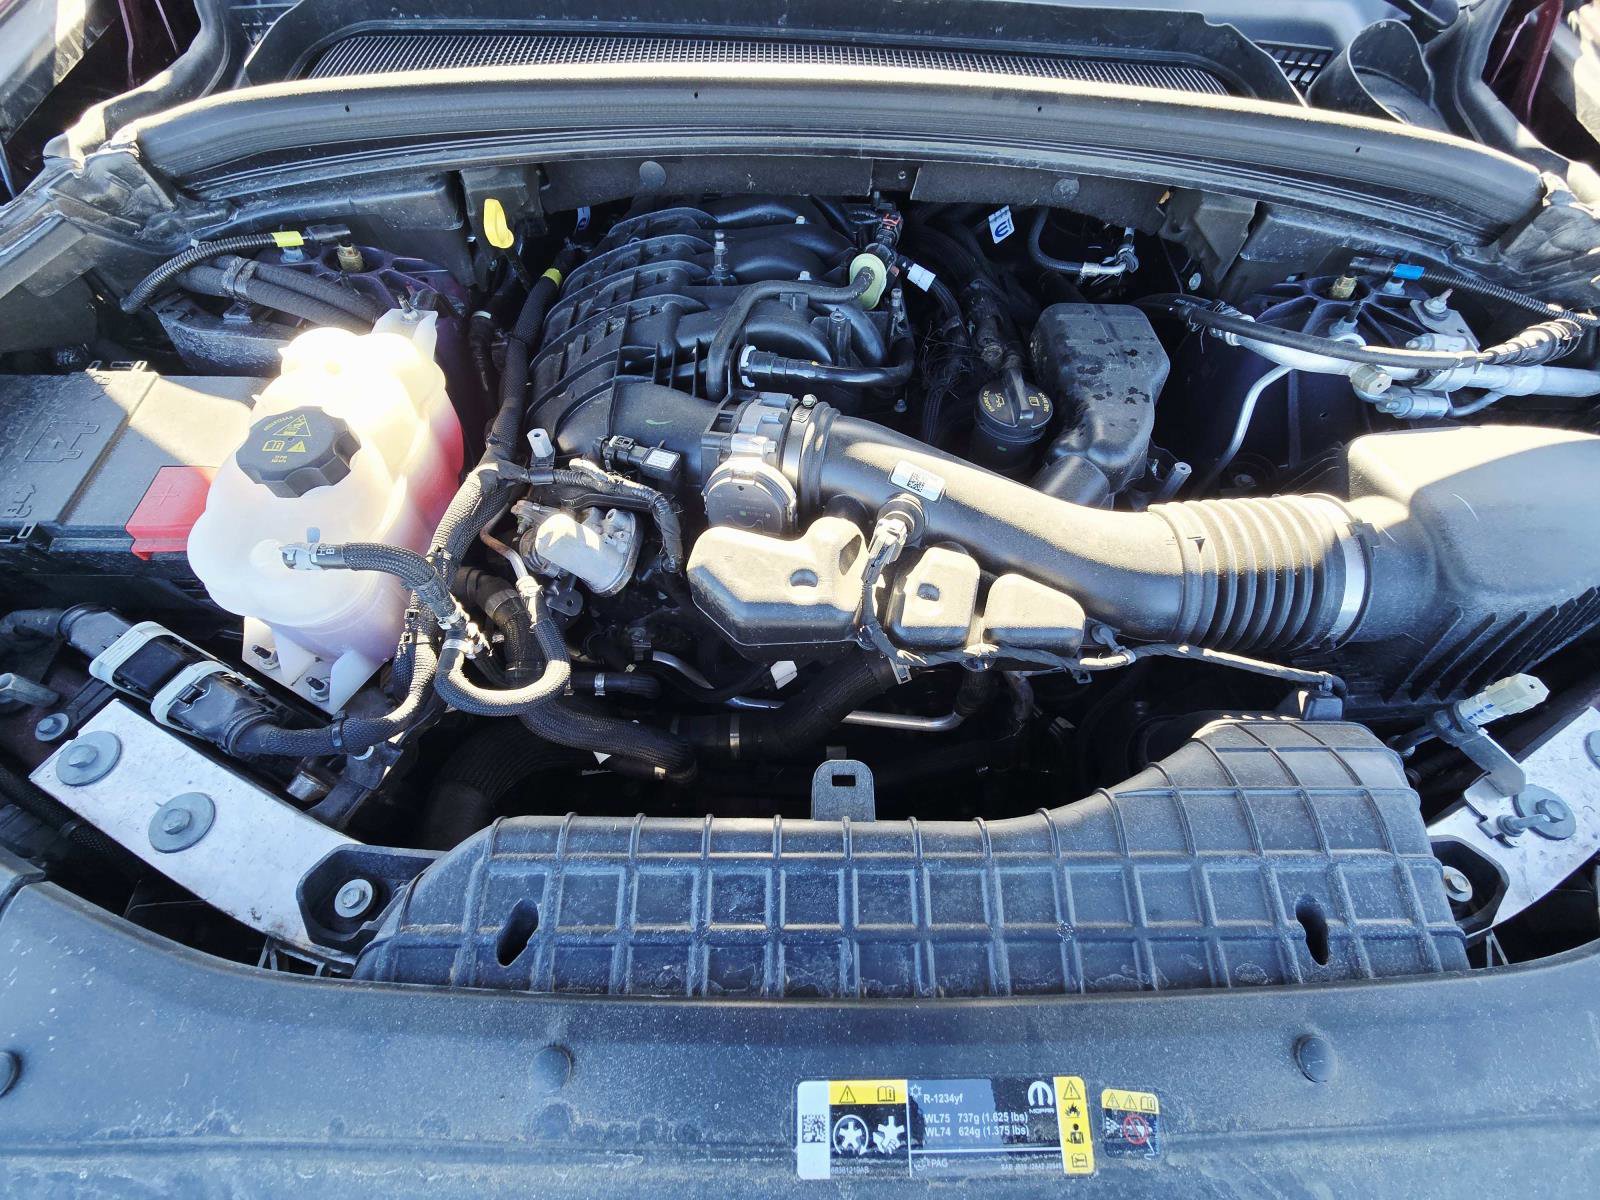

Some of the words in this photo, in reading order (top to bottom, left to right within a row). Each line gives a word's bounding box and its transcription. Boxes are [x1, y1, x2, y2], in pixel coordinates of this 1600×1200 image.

[923, 1093, 963, 1105] R-1234yf
[925, 1113, 951, 1124] WL75
[958, 1113, 980, 1125] 737g
[982, 1112, 1010, 1125] (1.625
[1011, 1111, 1029, 1123] lbs)
[925, 1126, 951, 1137] WL74
[958, 1126, 981, 1138] 624g
[983, 1125, 1011, 1138] (1.375
[1012, 1124, 1030, 1137] lbs)
[931, 1158, 949, 1168] PAG
